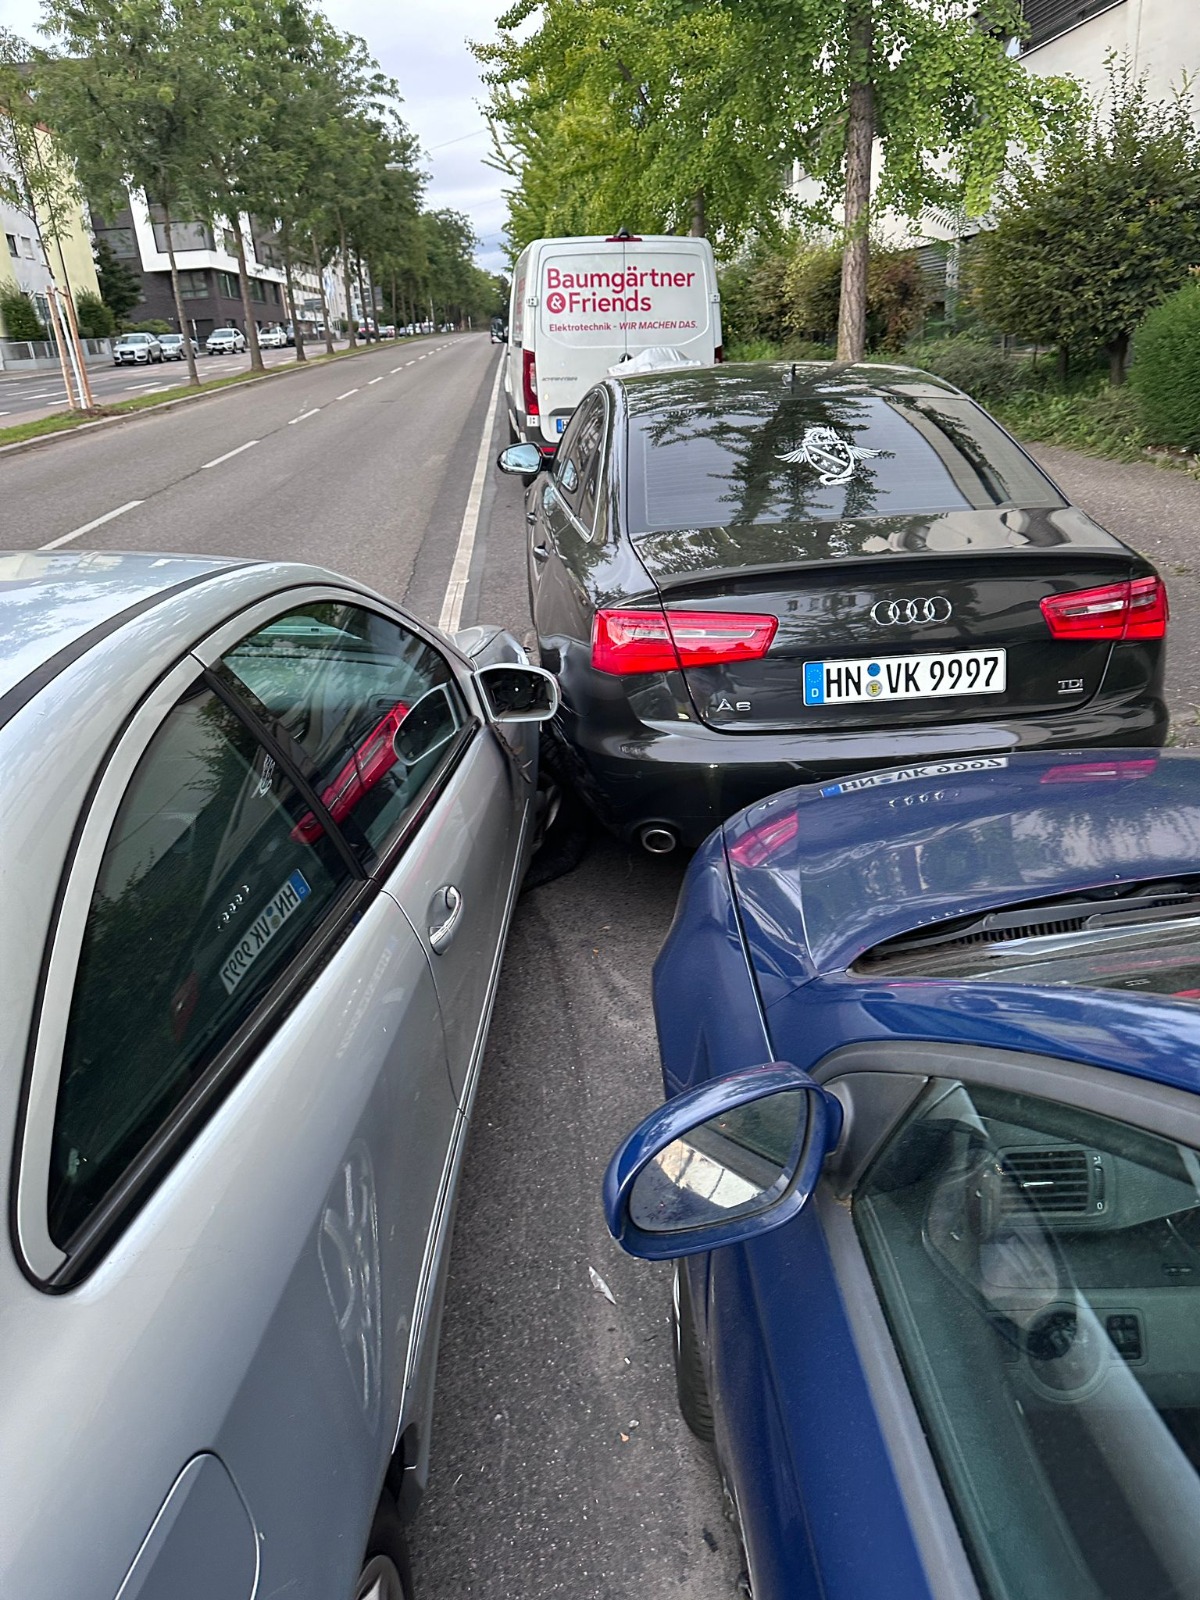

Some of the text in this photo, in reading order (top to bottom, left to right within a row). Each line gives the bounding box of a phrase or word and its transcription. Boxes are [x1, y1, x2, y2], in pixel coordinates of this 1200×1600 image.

[547, 266, 695, 293] Baumgärtner
[549, 322, 611, 332] Elektrotechnik
[619, 322, 637, 330] WIR
[638, 321, 677, 330] MACHEN
[678, 320, 698, 329] DAS.
[811, 657, 999, 698] D HN VK 9997
[1058, 678, 1083, 690] TDI
[716, 698, 751, 712] A6
